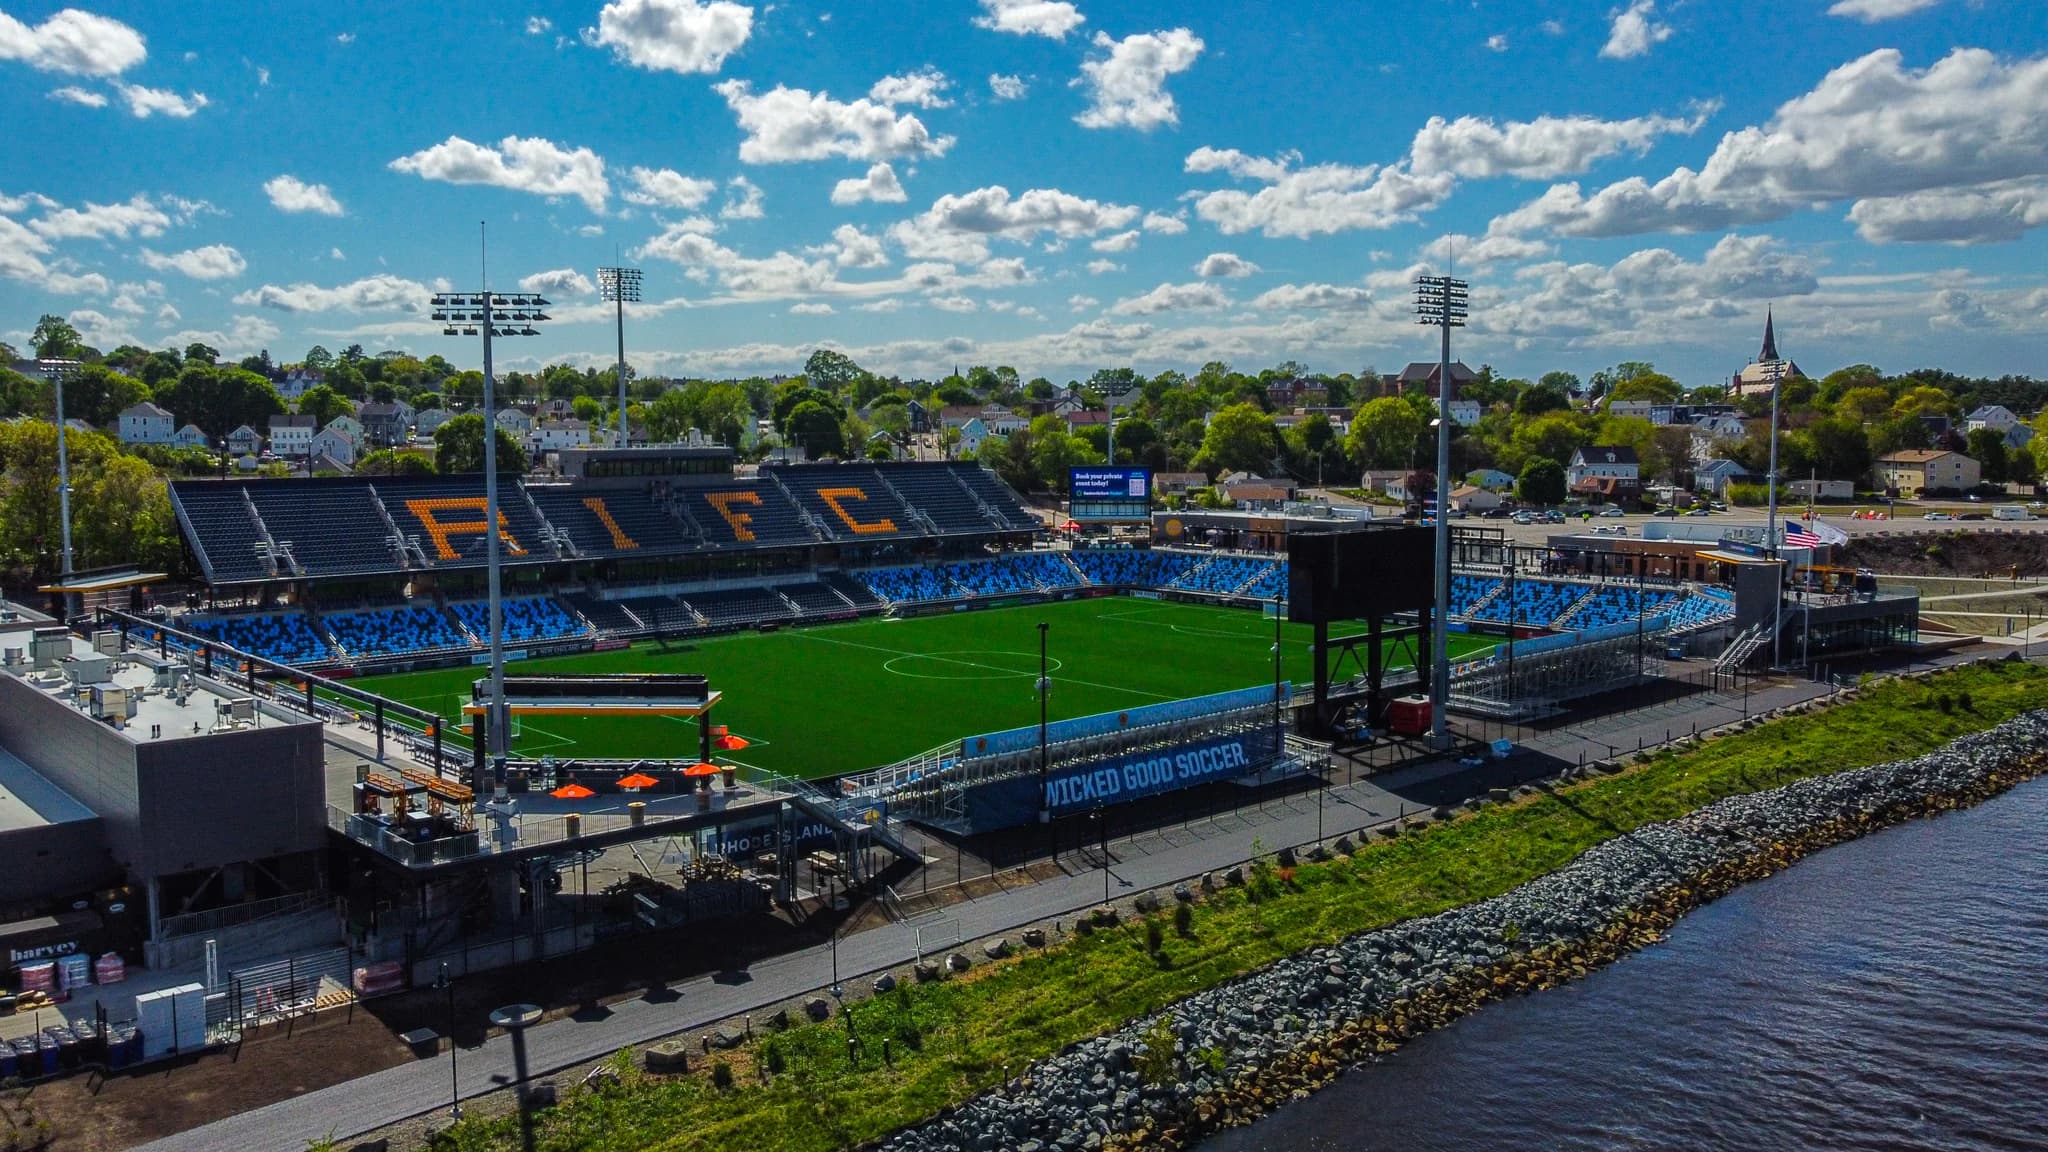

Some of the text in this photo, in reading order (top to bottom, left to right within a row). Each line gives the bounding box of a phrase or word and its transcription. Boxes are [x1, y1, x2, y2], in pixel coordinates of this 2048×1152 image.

[1123, 757, 1173, 790] GOOD
[1176, 742, 1249, 778] SOCCER.
[10, 940, 79, 962] harvey
